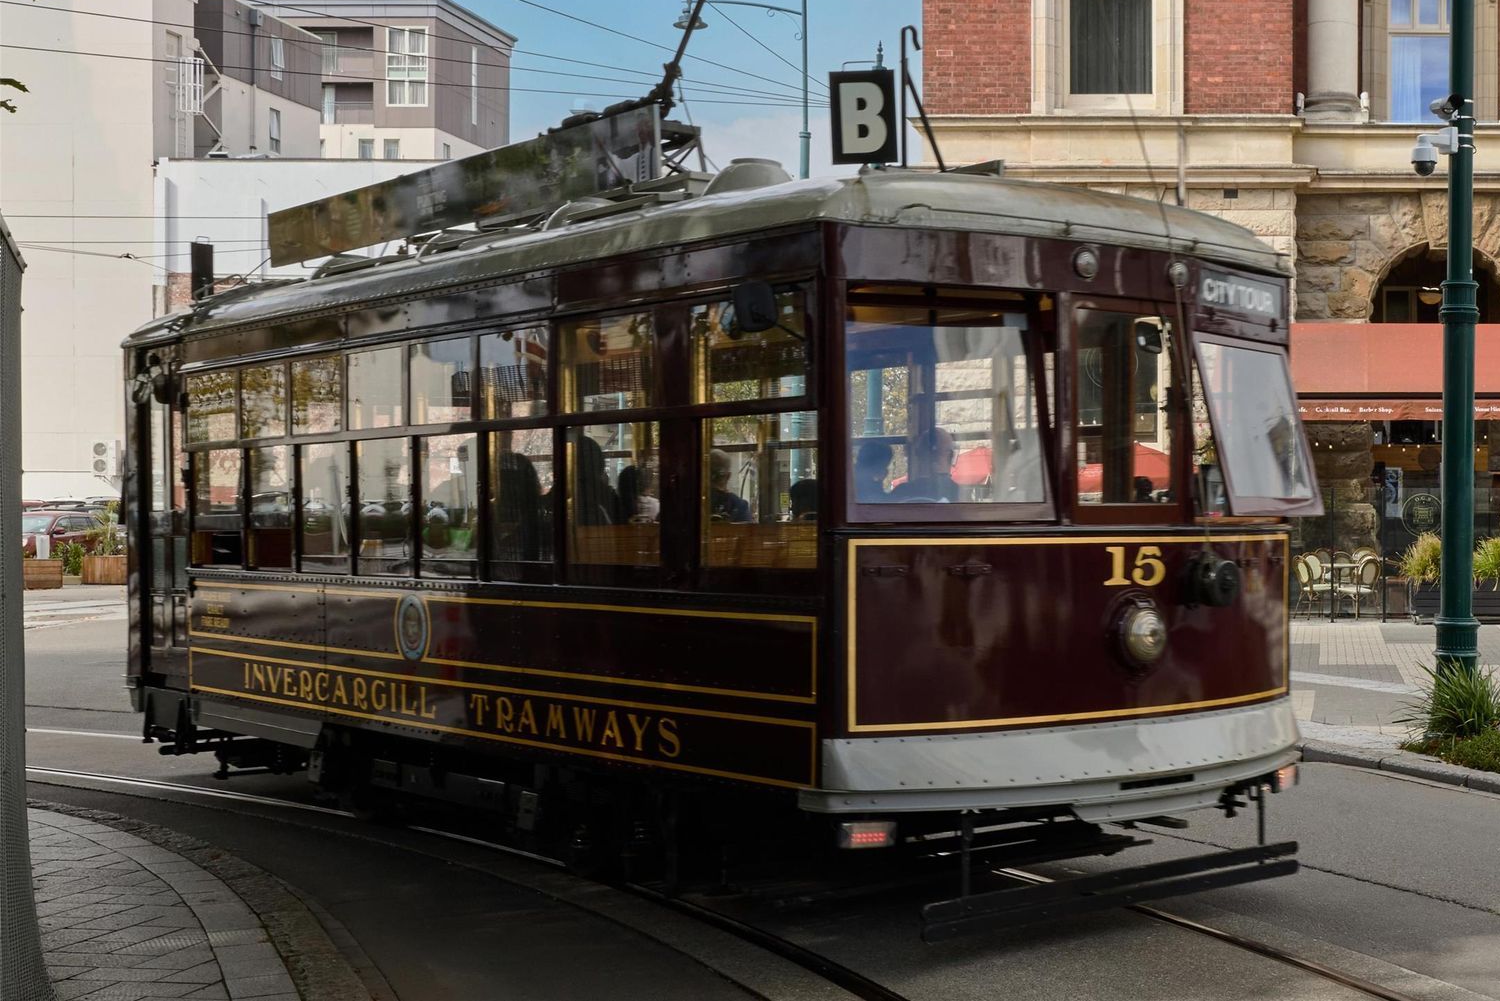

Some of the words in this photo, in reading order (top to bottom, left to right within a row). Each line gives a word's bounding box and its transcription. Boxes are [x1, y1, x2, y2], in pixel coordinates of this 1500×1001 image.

[839, 81, 888, 154] B
[1203, 278, 1237, 305] CITY
[1237, 285, 1275, 313] TOUR
[1103, 545, 1166, 587] 15
[243, 662, 436, 719] INVERCARGILL
[470, 693, 681, 758] TRAMWAYS
